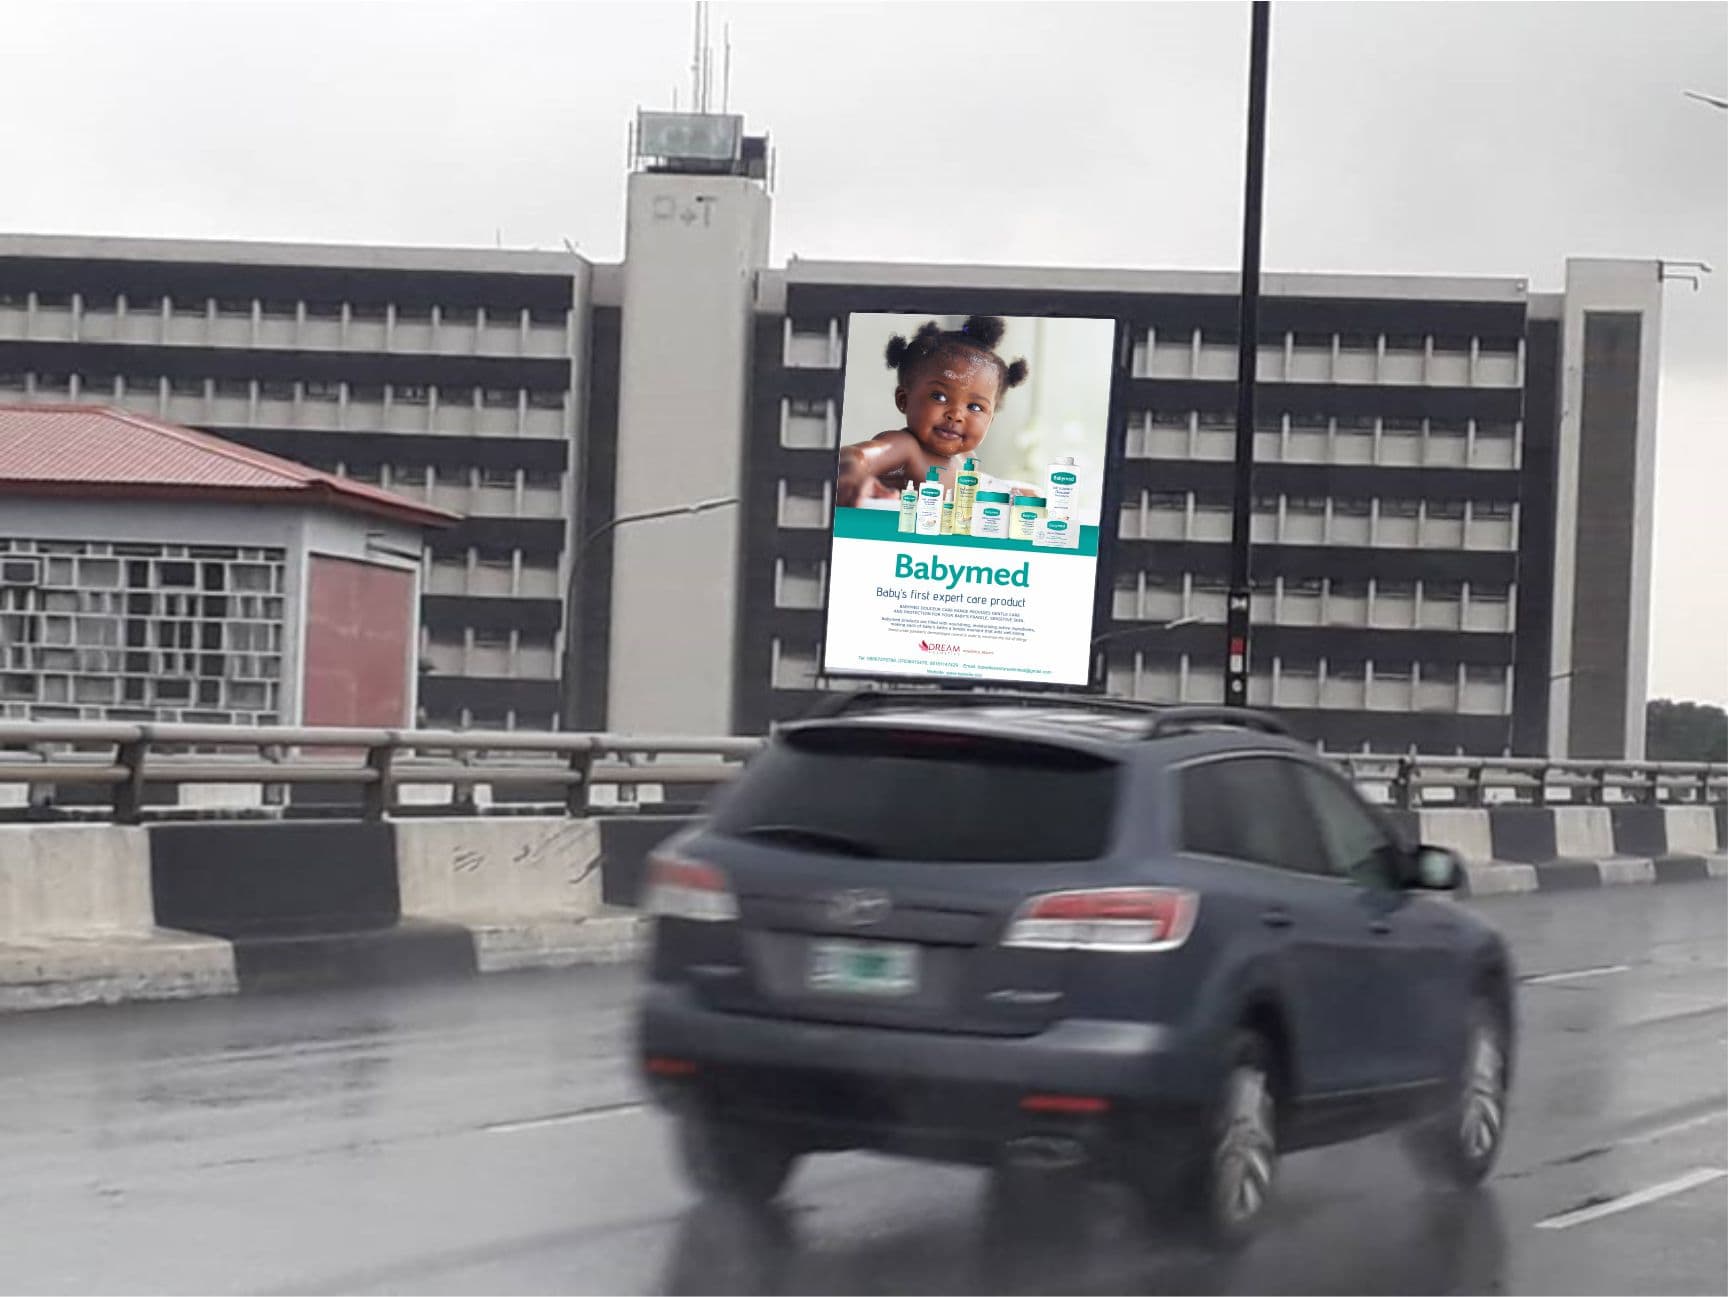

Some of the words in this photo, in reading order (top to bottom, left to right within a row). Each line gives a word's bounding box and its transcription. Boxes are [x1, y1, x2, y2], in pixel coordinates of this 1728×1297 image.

[895, 553, 1030, 590] Babymed
[876, 587, 908, 600] Baby's
[910, 589, 931, 601] first
[933, 592, 964, 604] expert
[966, 596, 988, 605] care
[990, 597, 1026, 607] product
[928, 643, 961, 653] DREAM
